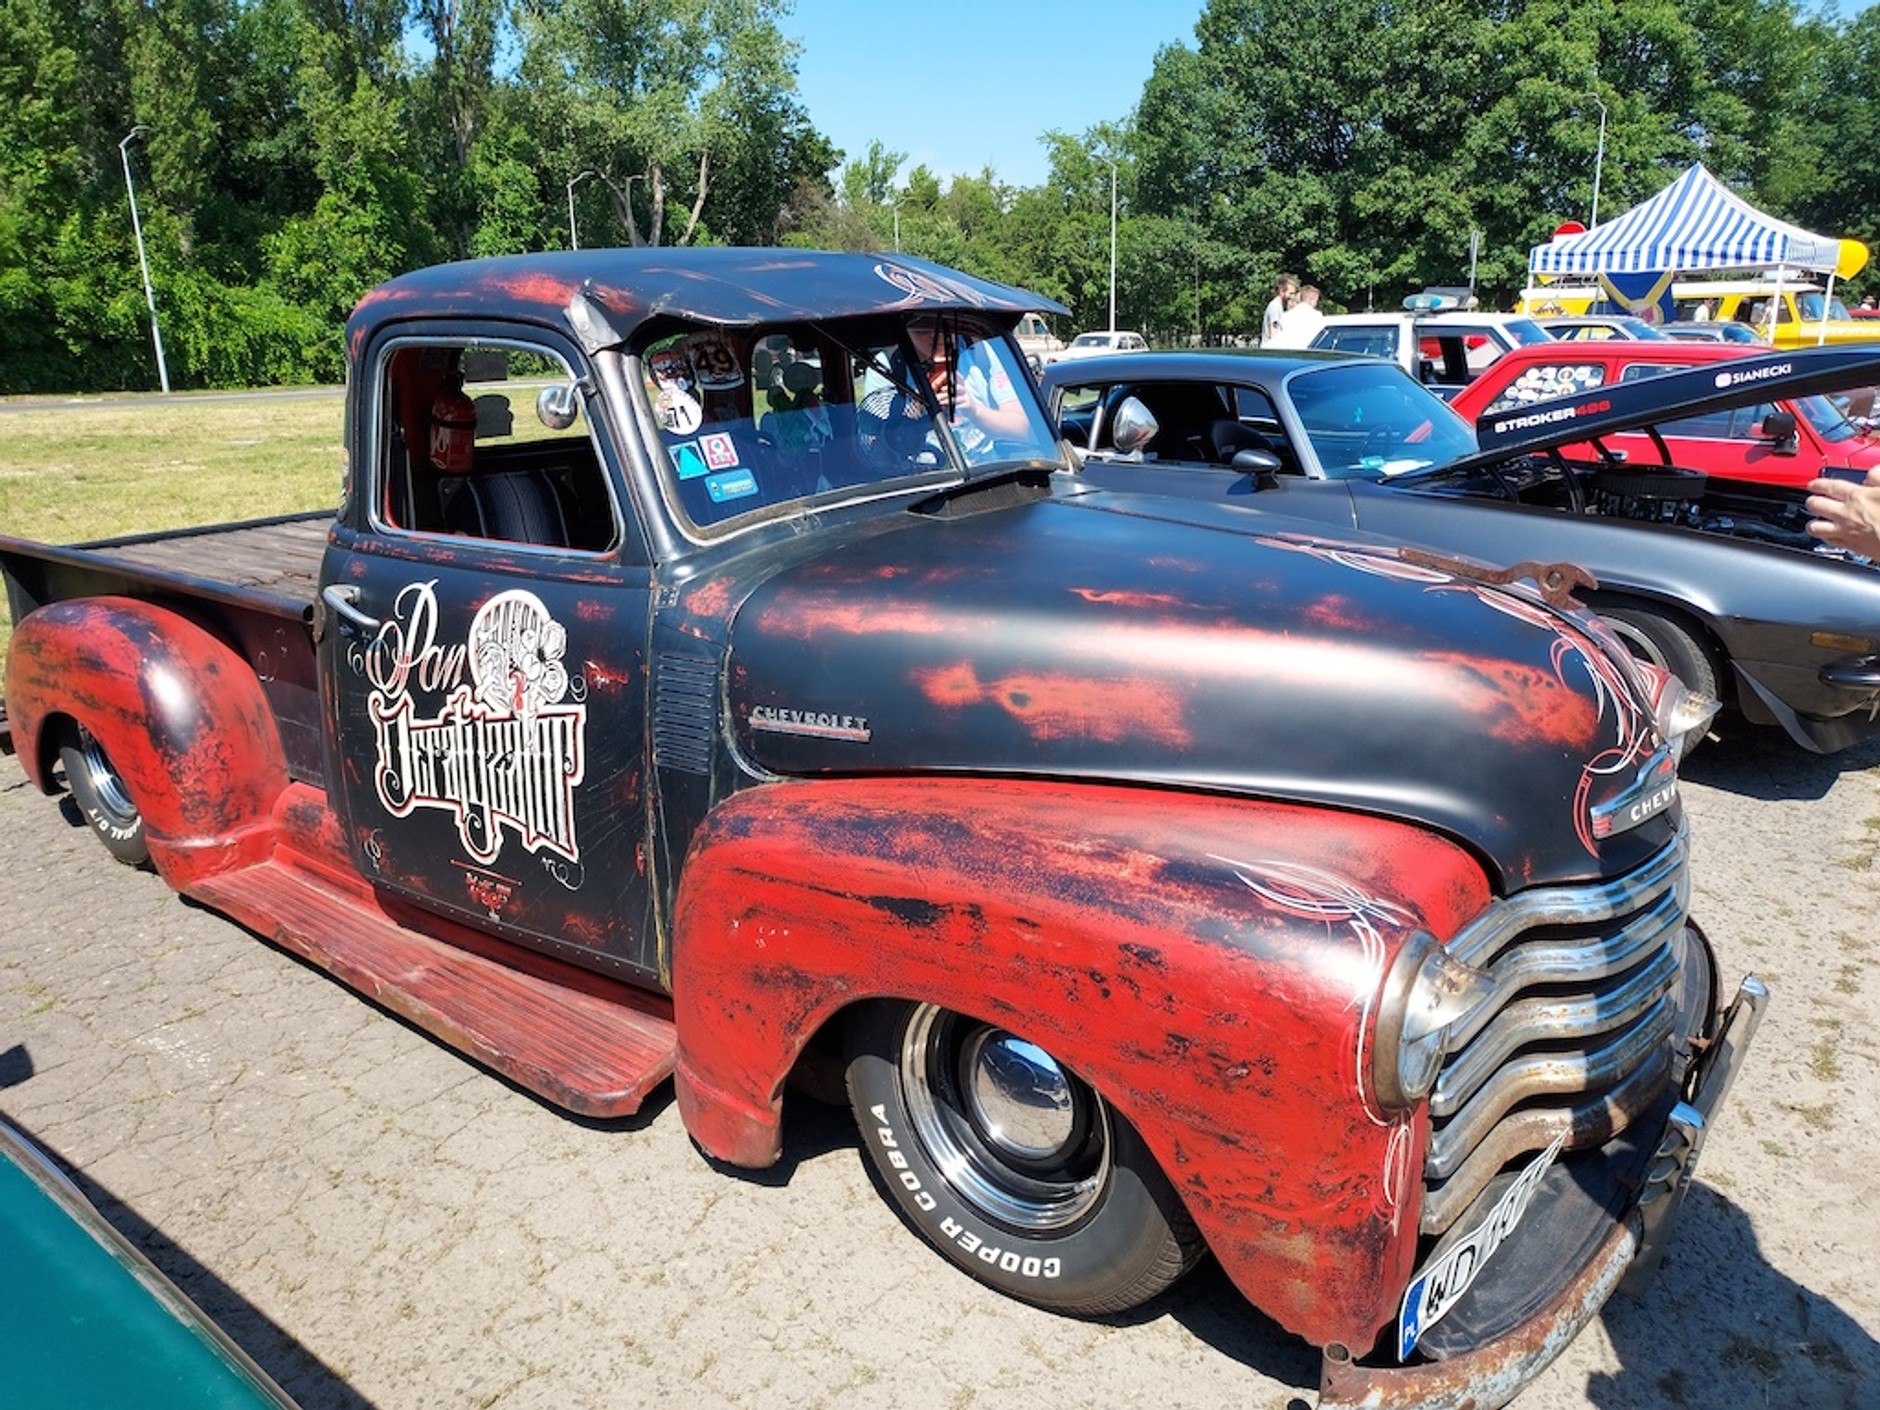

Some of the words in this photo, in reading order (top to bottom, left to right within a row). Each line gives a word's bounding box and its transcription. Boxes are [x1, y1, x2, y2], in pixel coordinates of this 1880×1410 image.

[1732, 362, 1793, 385] SIANECKI
[667, 404, 693, 429] 71
[366, 578, 468, 698] Pan
[751, 704, 869, 731] CHEVROLET
[870, 1103, 938, 1212] COBRA
[939, 1216, 1061, 1279] COOPER
